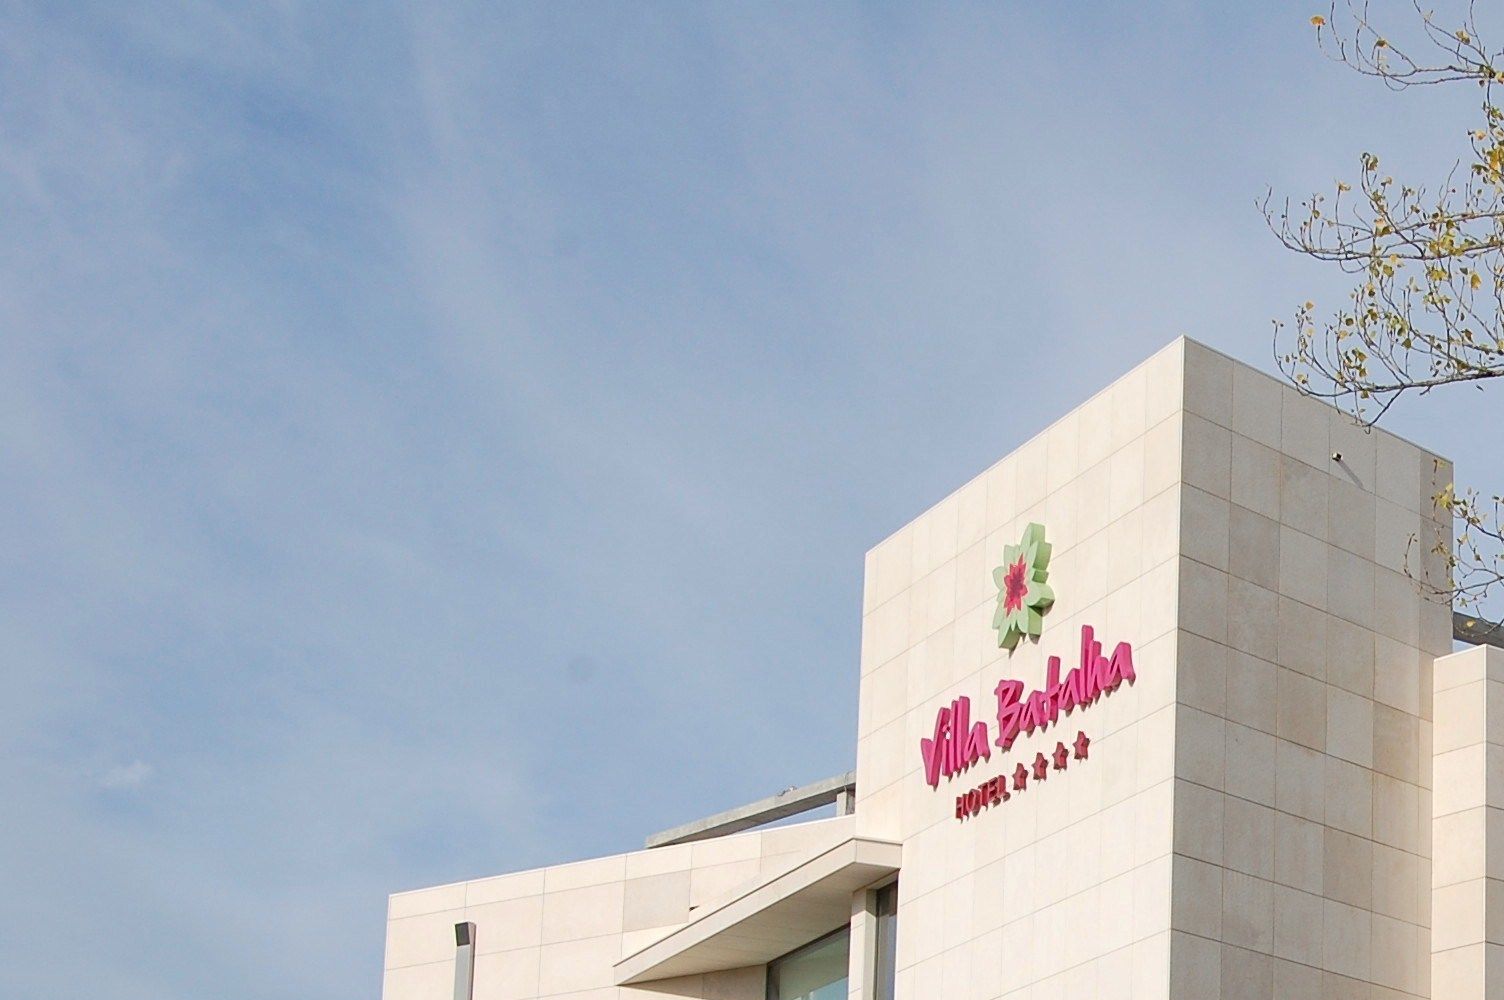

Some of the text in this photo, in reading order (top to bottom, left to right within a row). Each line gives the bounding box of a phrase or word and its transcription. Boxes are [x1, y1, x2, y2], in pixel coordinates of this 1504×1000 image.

[920, 624, 1136, 788] Villa Batalha
[955, 774, 1010, 821] HOTEL
